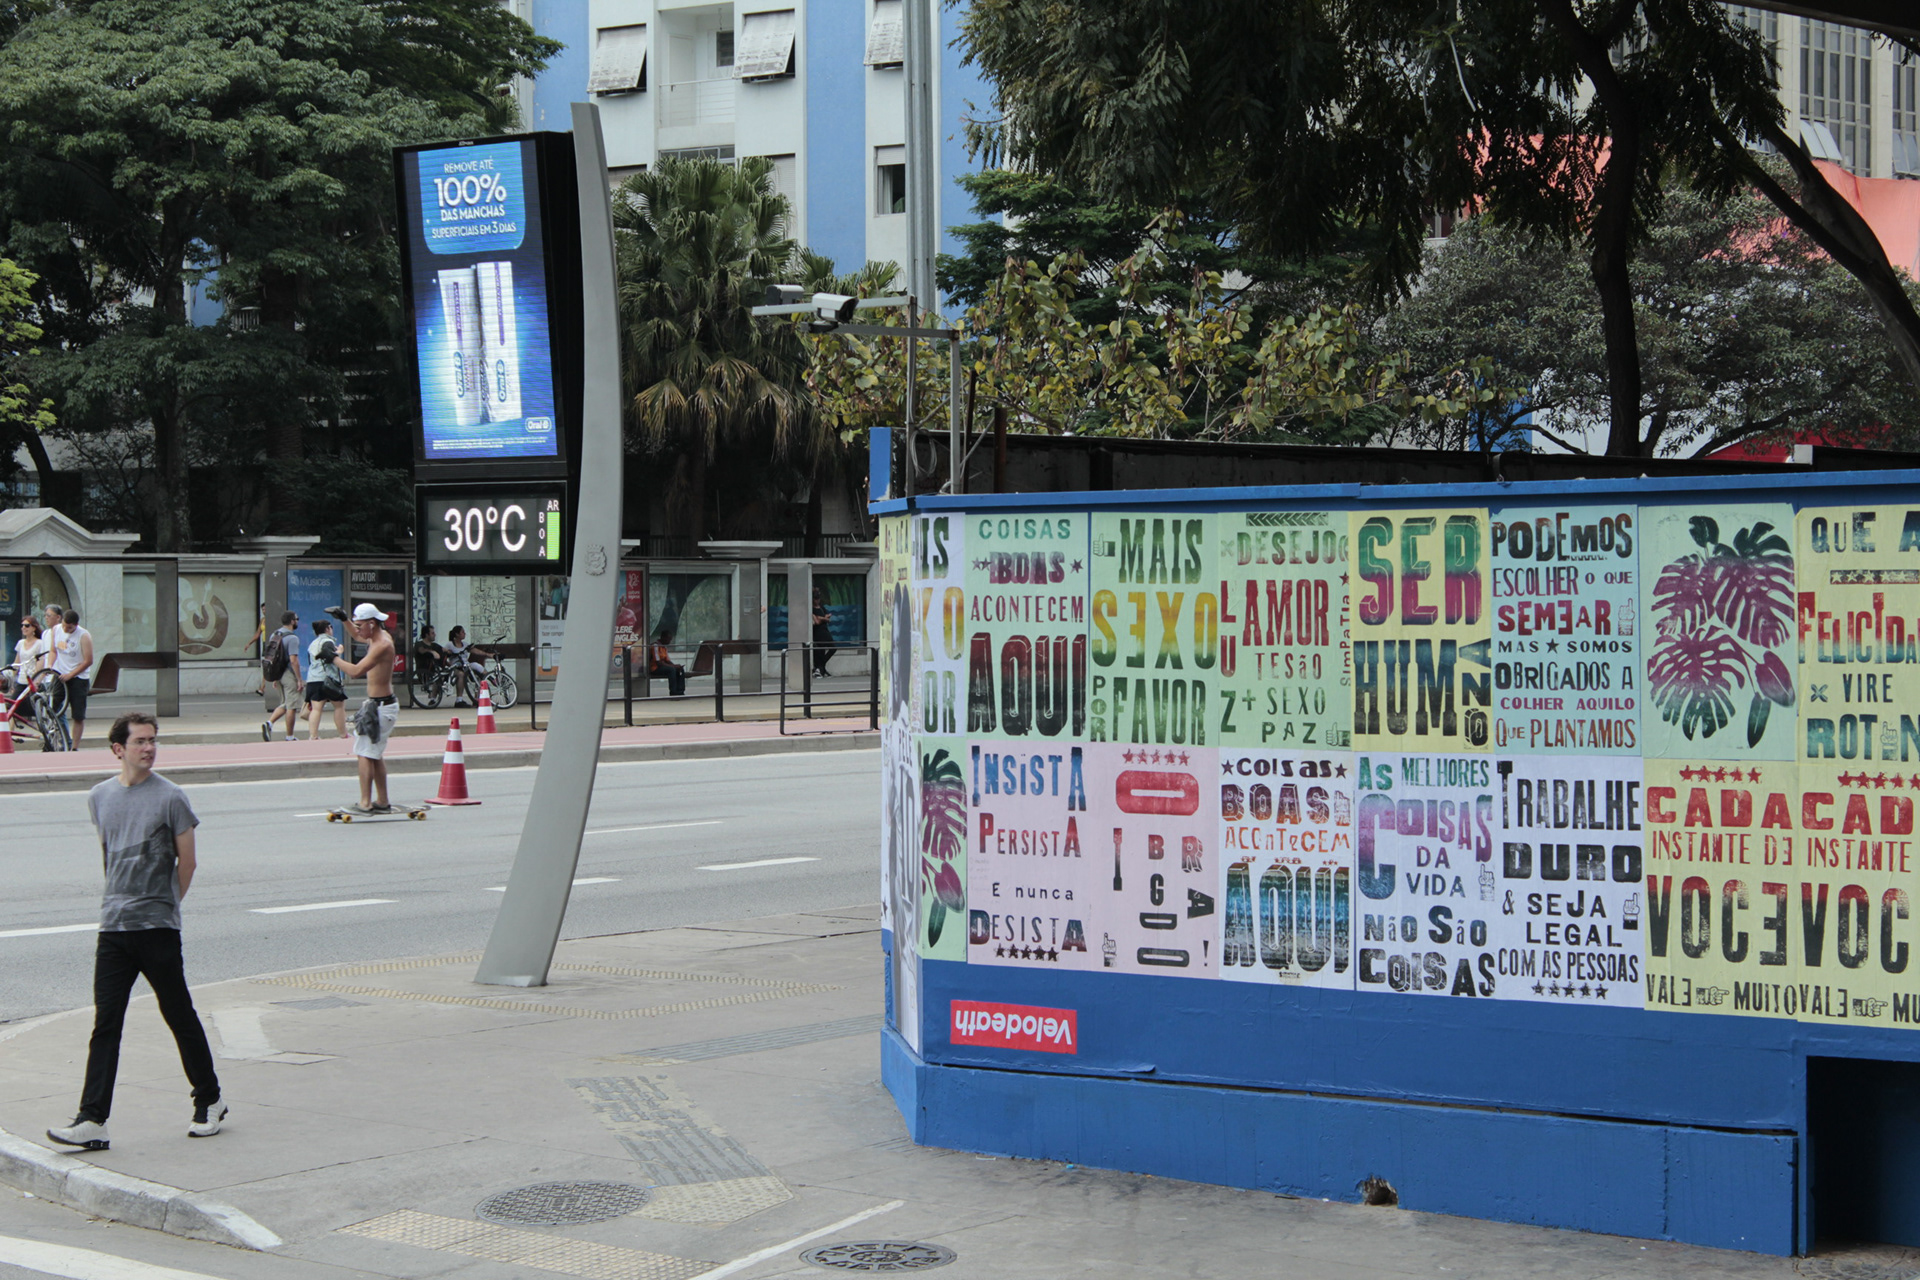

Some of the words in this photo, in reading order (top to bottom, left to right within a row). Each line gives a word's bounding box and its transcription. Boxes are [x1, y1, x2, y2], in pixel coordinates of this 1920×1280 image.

[444, 160, 478, 173] REMOVE
[479, 155, 494, 170] ATÉ
[434, 173, 507, 208] 100%
[432, 224, 479, 238] SUPERFICIAIS
[480, 224, 491, 235] EM
[491, 221, 499, 234] 3
[500, 222, 517, 233] DIAS
[441, 208, 458, 222] DAS
[460, 204, 505, 220] MANCHAS
[547, 500, 559, 511] AR
[444, 504, 526, 552] 30°C
[979, 518, 1071, 540] COISAS
[1491, 512, 1633, 561] PODEMOS
[1811, 512, 1876, 553] QUE
[1119, 518, 1202, 584] MAIS
[300, 574, 331, 586] Músicas
[352, 572, 376, 582] AVIATOR
[1358, 515, 1482, 626] SER
[1493, 566, 1579, 597] ESCOLHER
[1585, 572, 1595, 585] O
[1604, 571, 1633, 585] QUE
[971, 595, 1083, 623] ACONTECEM
[1242, 579, 1329, 646] AMOR
[1498, 599, 1611, 636] SEMEAR
[1092, 589, 1218, 670] SEXO
[1798, 592, 1920, 664] FELICIDA
[1499, 641, 1539, 653] MAS
[1567, 640, 1633, 653] SOMOS
[967, 632, 1086, 736] AQUI
[1494, 662, 1610, 691] OBRIGADOS
[1622, 666, 1633, 690] A
[1842, 673, 1893, 703] VIRE
[1112, 677, 1206, 746] FAVOR
[1267, 687, 1326, 715] SEXO
[1500, 698, 1563, 710] COLHER
[1576, 697, 1635, 711] AQUILO
[1262, 722, 1317, 744] PAZ
[1530, 718, 1636, 748] PLANTAMOS
[1402, 757, 1489, 788] MELHORES
[1221, 783, 1330, 824] BOAS
[1497, 761, 1641, 831] TRABALHE
[1647, 786, 1792, 829] CADA
[979, 812, 1081, 858] PERSISTA
[1359, 793, 1493, 900] COISAS
[1652, 830, 1751, 864] INSTANTE
[1764, 834, 1792, 866] DE
[1417, 845, 1450, 870] DA
[1503, 842, 1642, 883] DURO
[1807, 837, 1912, 873] INSTANTE
[992, 882, 1000, 897] E
[1016, 886, 1073, 901] nunca
[1405, 872, 1466, 898] VIDA
[1223, 862, 1350, 974] AQUI
[1502, 889, 1515, 915] &
[1527, 890, 1606, 918] SEJA
[969, 909, 1087, 952] DESISTA
[1526, 922, 1623, 947] LEGAL
[1801, 882, 1909, 974] VOC
[1359, 948, 1496, 998] COISAS
[1499, 948, 1535, 977] COM
[1542, 951, 1562, 979] AS
[1567, 952, 1639, 983] PESSOAS
[1646, 973, 1692, 1006] VALE
[1734, 981, 1797, 1016] MUITO
[1799, 983, 1848, 1017] VALE
[955, 1010, 1072, 1045] Velodeath
